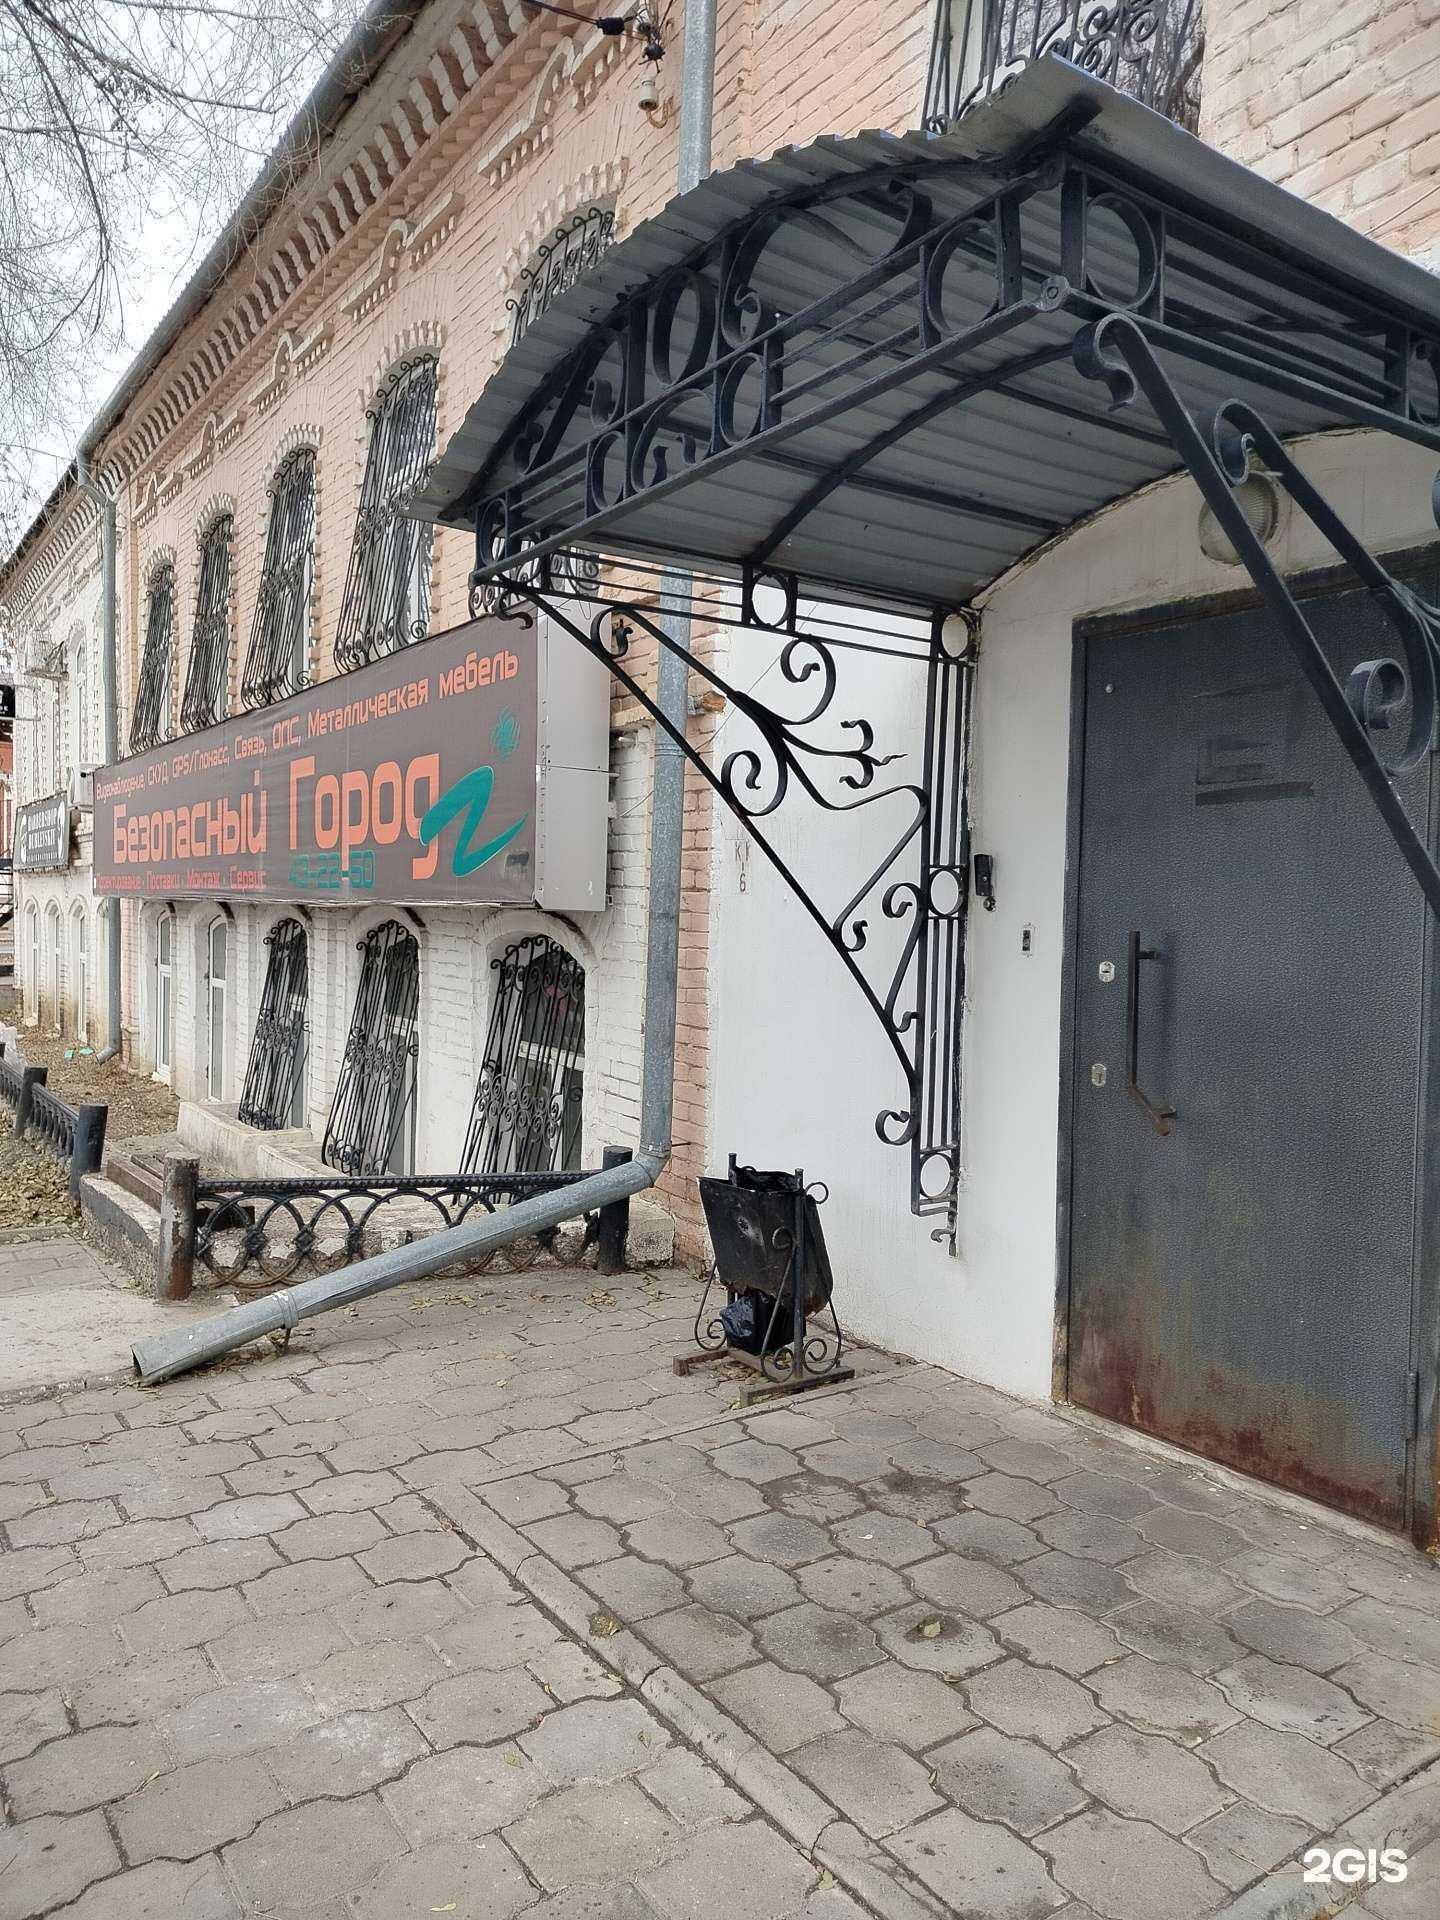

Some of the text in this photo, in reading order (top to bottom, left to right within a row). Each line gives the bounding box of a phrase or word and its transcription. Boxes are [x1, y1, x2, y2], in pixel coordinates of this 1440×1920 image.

[234, 735, 267, 760] Связь,
[272, 715, 301, 749] ОПС,
[308, 679, 429, 738] Металлическая
[439, 650, 519, 699] мебель
[113, 753, 440, 880] Безопасный Город
